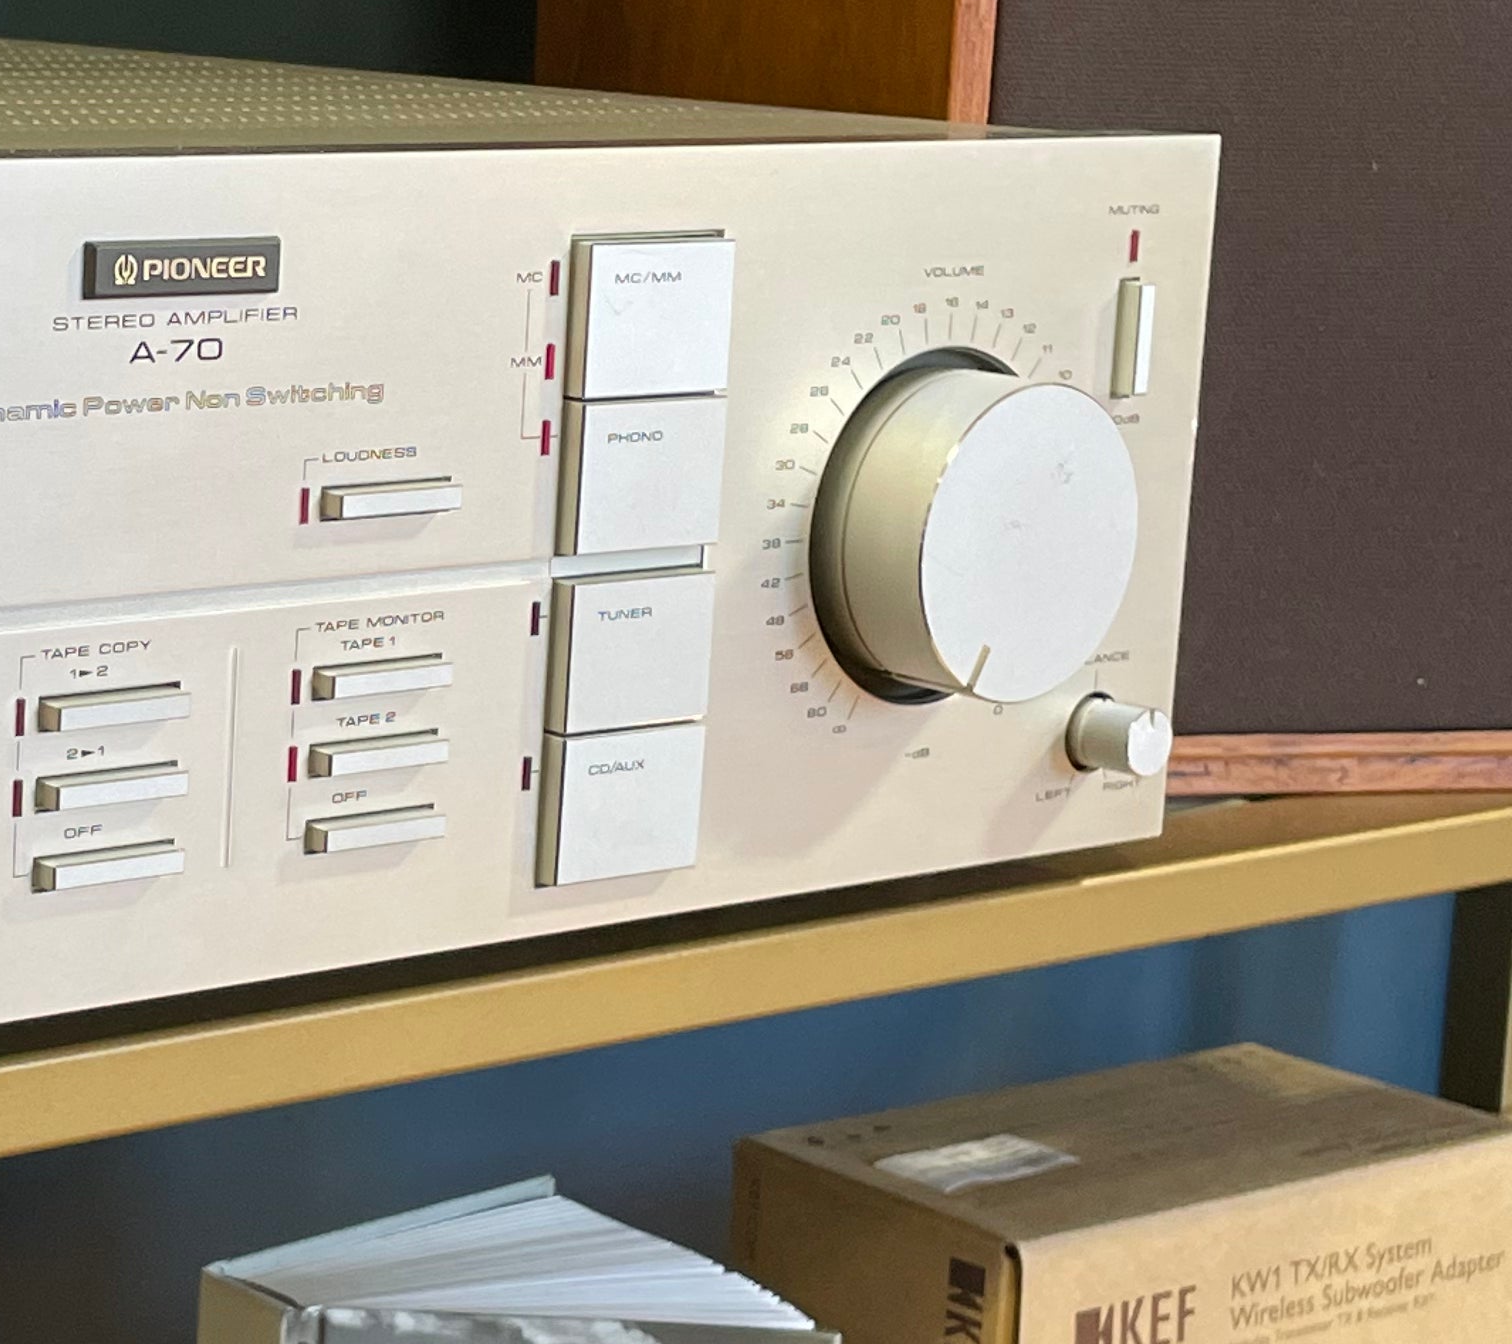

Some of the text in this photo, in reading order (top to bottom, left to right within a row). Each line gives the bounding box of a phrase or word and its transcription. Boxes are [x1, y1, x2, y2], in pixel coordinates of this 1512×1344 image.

[1107, 204, 1160, 216] MUTING
[142, 256, 267, 282] PIONEER
[923, 264, 985, 280] VOLUME
[515, 271, 544, 285] MC
[614, 270, 682, 285] MC/MM
[974, 299, 990, 311] 14
[51, 306, 300, 333] STEREO AMPLIFIER
[880, 314, 901, 326] 20
[1000, 308, 1015, 320] 13
[854, 332, 874, 345] 22
[129, 338, 224, 366] A-70
[510, 355, 543, 369] MM
[831, 356, 851, 368] 24
[82, 393, 180, 419] Power
[185, 388, 241, 411] Non
[245, 379, 386, 409] Switching
[606, 428, 664, 445] PHONO
[321, 446, 418, 465] LOUDNESS
[775, 459, 796, 471] 30
[766, 498, 786, 510] 34
[760, 578, 781, 590] 42
[314, 610, 446, 634] TAPE MONITOR
[598, 606, 654, 622] TUNER
[40, 639, 153, 660] TAPE COPY
[340, 637, 385, 653] TAPE
[1084, 650, 1131, 666] ANCE
[335, 711, 397, 729] TAPE 2
[587, 759, 646, 776] CD/AUX
[331, 790, 369, 805] OFF
[1035, 786, 1071, 803] LEFT
[63, 824, 104, 840] OFF
[1230, 1264, 1281, 1302] KW1
[1365, 1237, 1433, 1274] System
[1229, 1295, 1315, 1331] Wireless
[1430, 1249, 1506, 1285] Adapter
